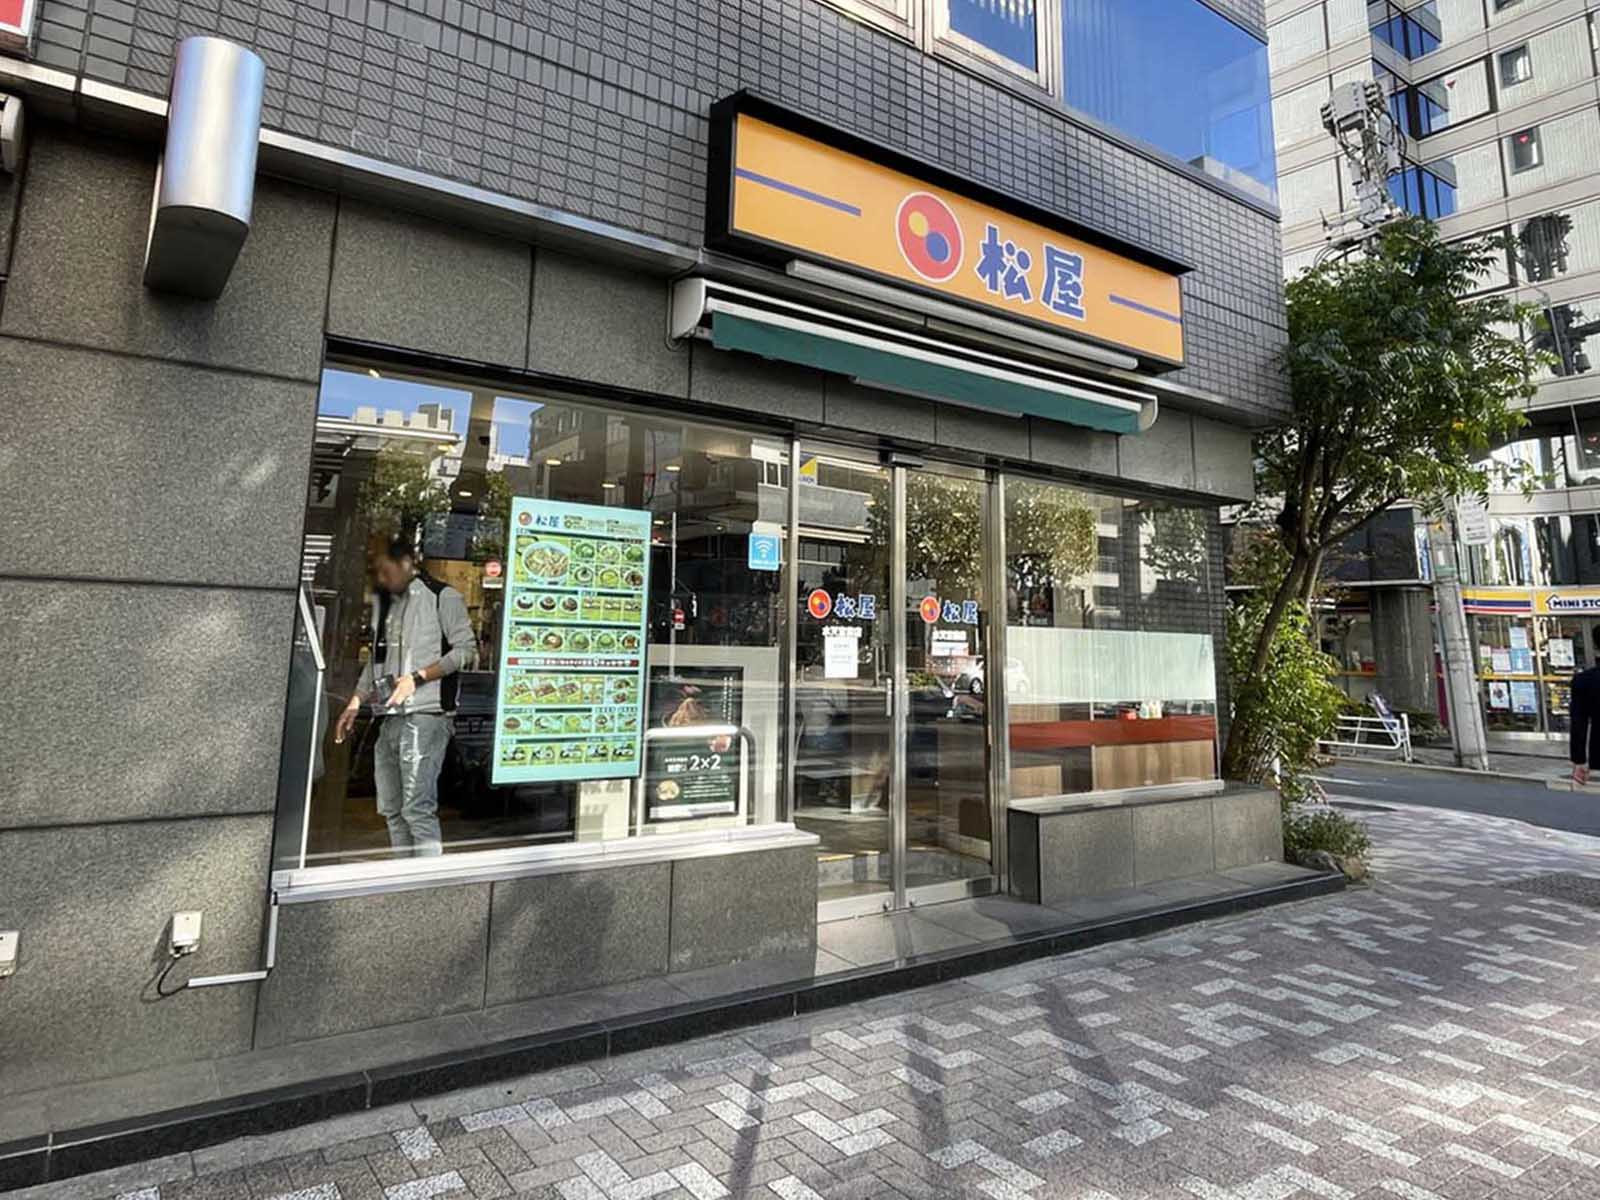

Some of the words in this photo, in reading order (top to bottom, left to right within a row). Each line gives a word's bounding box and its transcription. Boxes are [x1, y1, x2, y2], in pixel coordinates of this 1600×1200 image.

[975, 224, 1087, 320] 松屋
[536, 514, 559, 527] 松屋
[834, 593, 876, 619] 松屋
[942, 600, 978, 625] 松屋
[1553, 599, 1580, 608] MINI
